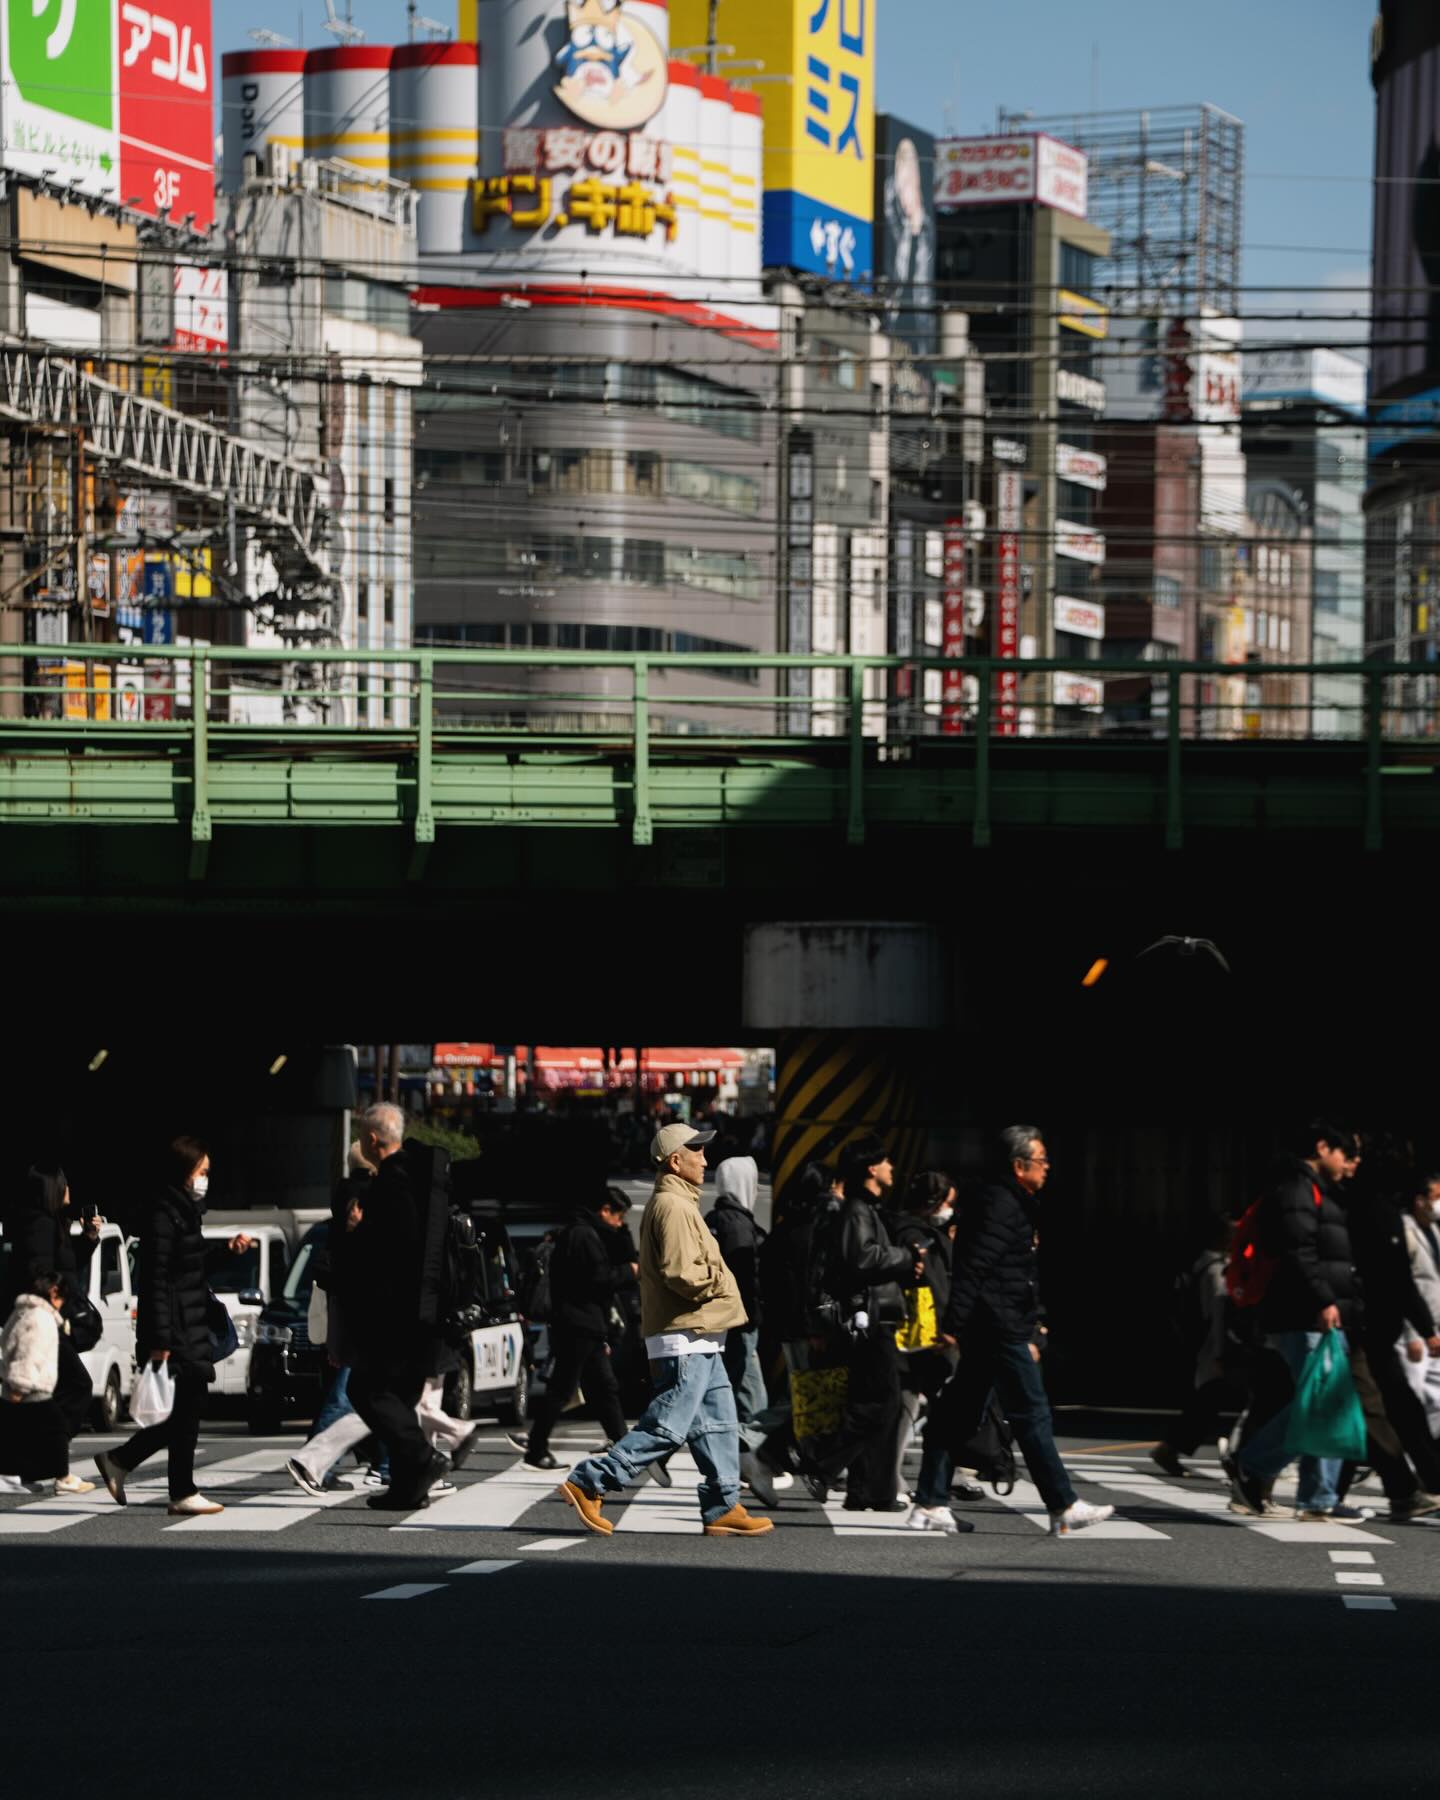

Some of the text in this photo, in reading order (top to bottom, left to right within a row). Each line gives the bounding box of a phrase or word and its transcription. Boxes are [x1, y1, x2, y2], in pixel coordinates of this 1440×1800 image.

[122, 3, 207, 93] アコム
[153, 168, 181, 209] 3F
